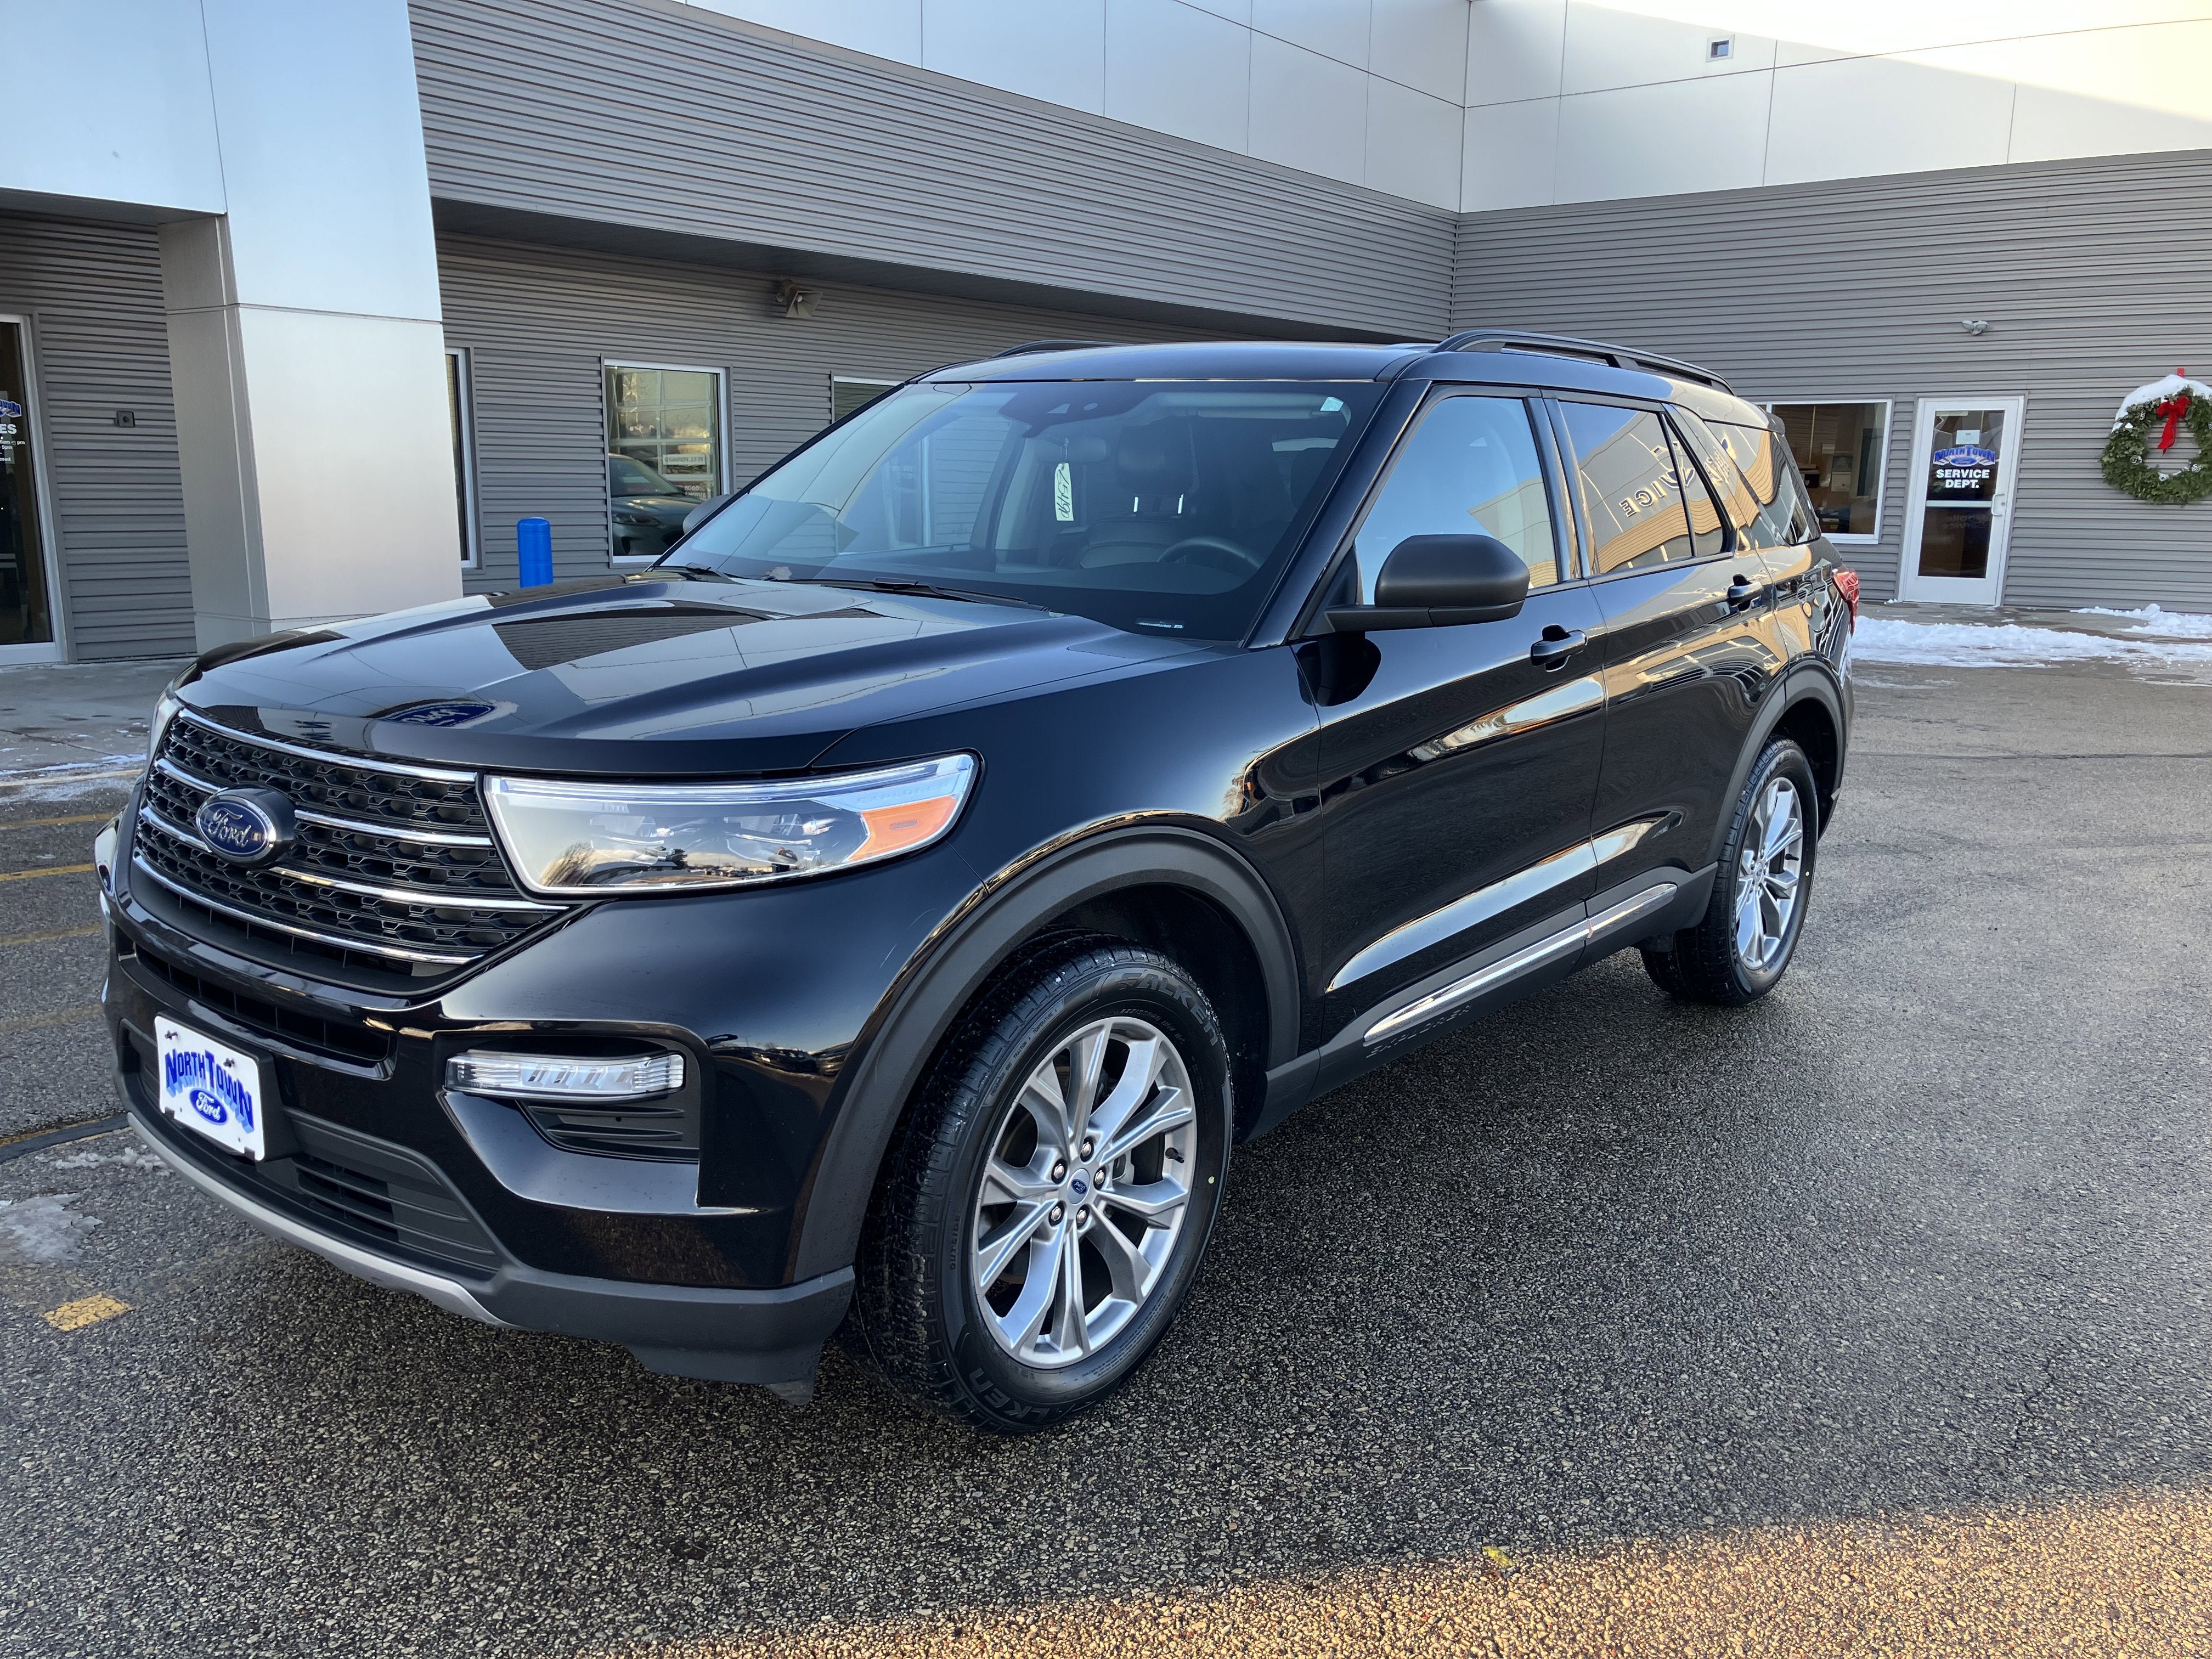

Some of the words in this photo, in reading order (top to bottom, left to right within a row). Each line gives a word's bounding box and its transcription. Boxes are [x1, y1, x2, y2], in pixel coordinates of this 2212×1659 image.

[1936, 469, 1990, 478] SERVICE
[1945, 479, 1979, 488] DEPT.
[857, 782, 948, 804] EXPLORER
[208, 807, 252, 848] Ford
[1365, 1005, 1474, 1058] EXPLORER
[196, 1091, 221, 1121] Ford
